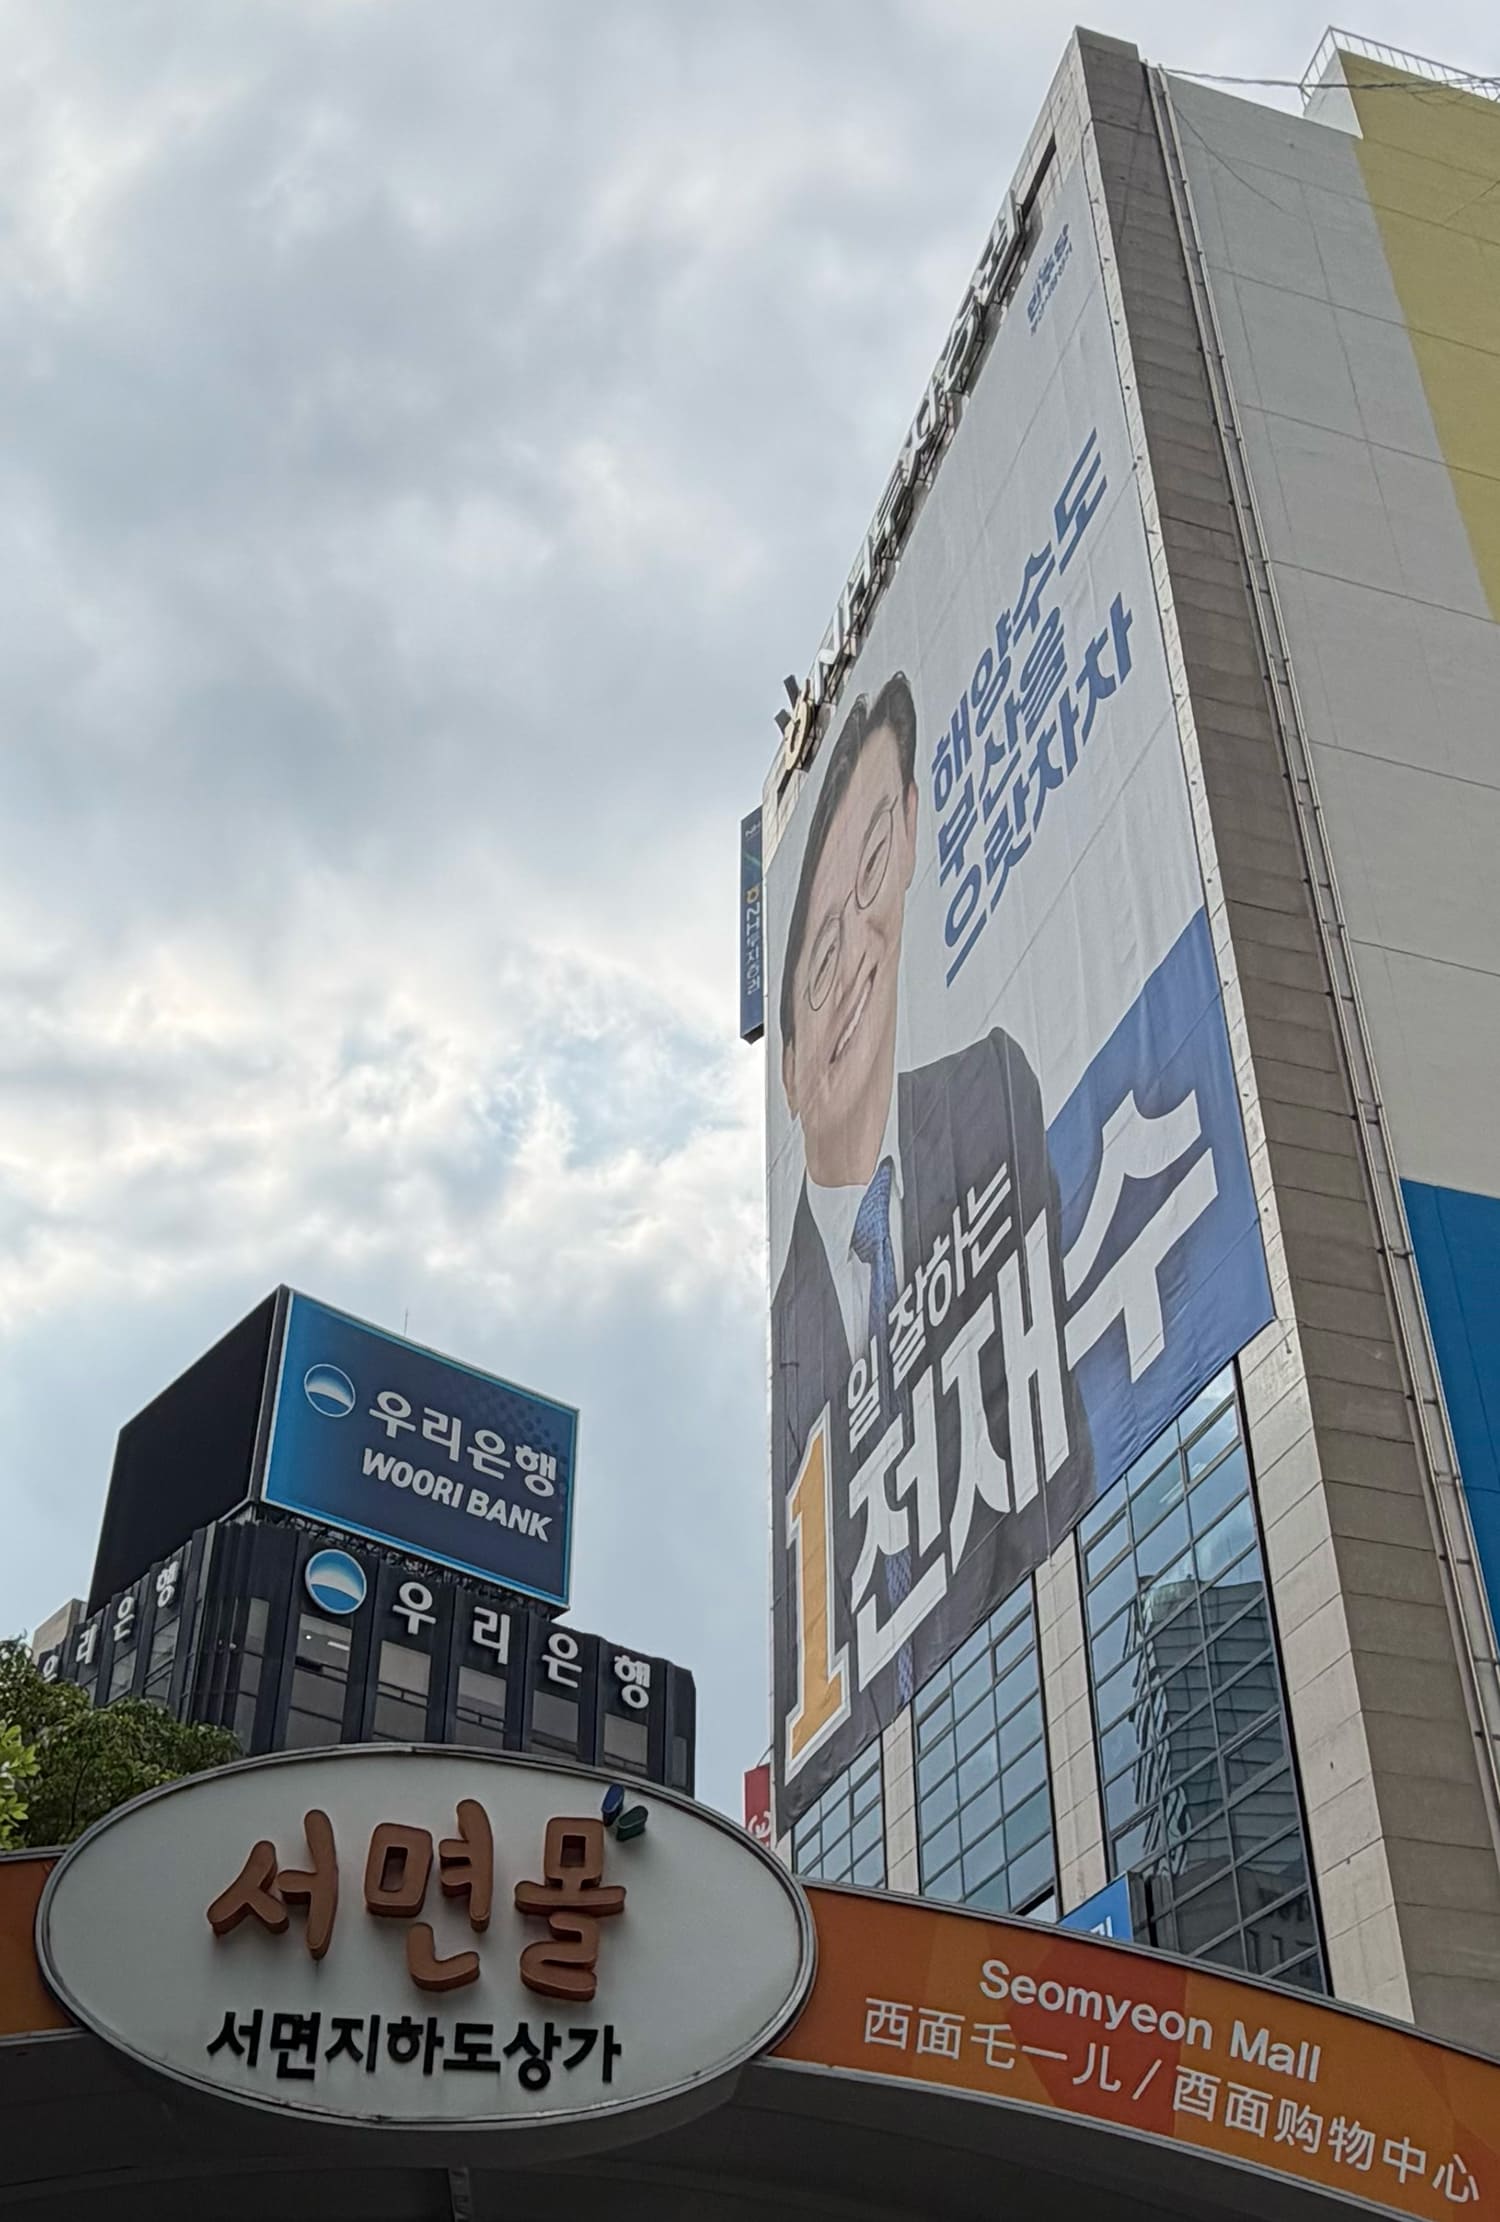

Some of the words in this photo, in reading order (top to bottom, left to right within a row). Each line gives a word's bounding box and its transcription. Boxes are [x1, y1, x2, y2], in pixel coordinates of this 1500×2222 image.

[931, 427, 1108, 813] 해양수도
[937, 605, 1069, 887] 부산을
[944, 591, 1134, 988] 으랏차차
[847, 1335, 881, 1452] 일
[888, 1161, 1013, 1391] 잘하는
[362, 1447, 465, 1509] WOORI
[466, 1488, 553, 1543] BANK
[368, 1390, 557, 1498] 우리은행
[785, 1400, 852, 1787] 1
[849, 1088, 1219, 1693] 전재수
[392, 1581, 651, 1709] 우리은행
[206, 1799, 627, 2001] 서면몰
[207, 2008, 623, 2091] 서면지하도상가
[979, 1958, 1213, 2052] Seomyeon
[1229, 2019, 1322, 2084] Mall
